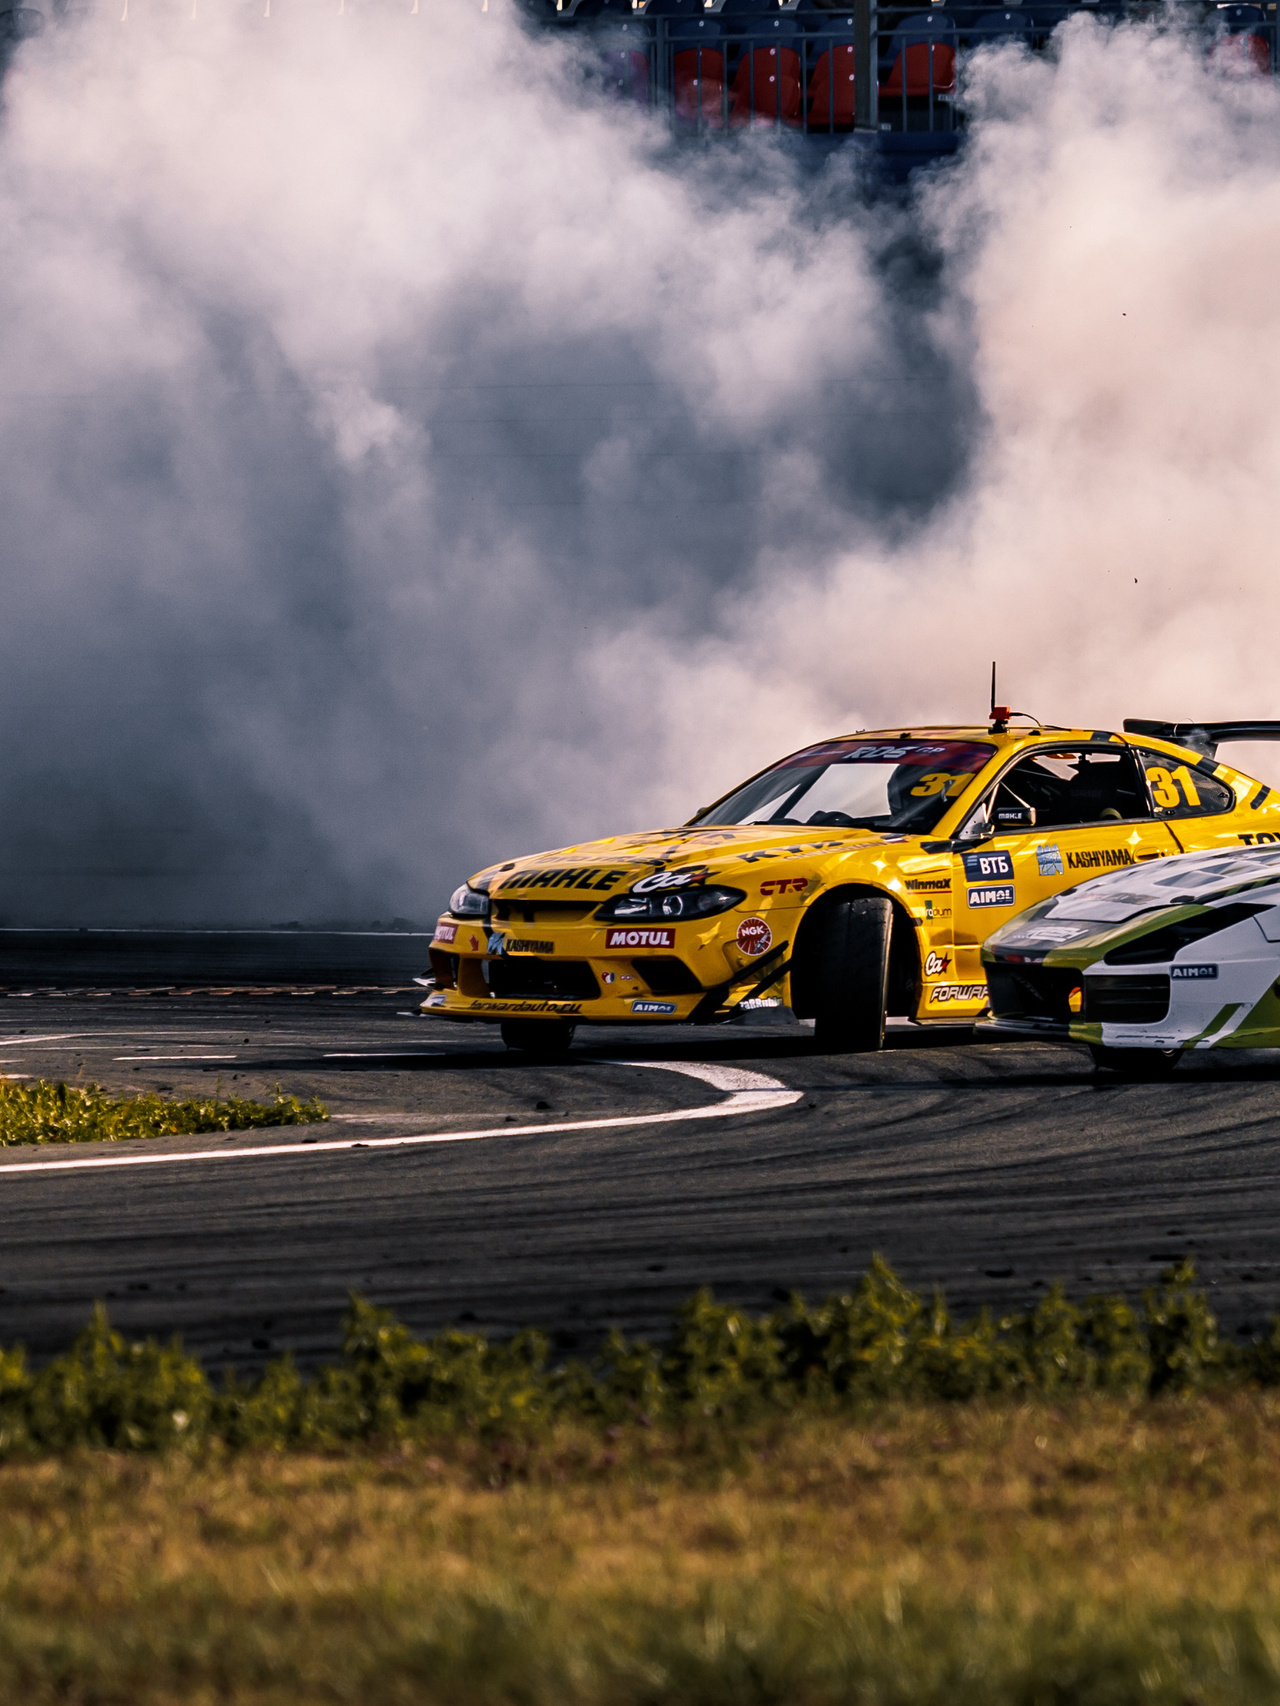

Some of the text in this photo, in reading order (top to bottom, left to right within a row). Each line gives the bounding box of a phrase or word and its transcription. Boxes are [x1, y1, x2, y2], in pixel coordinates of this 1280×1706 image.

[910, 773, 975, 796] 31
[1146, 766, 1201, 807] 31
[981, 856, 1009, 875] ВТБ
[1065, 848, 1132, 869] KASHIYAMA
[498, 869, 628, 890] MAHLE
[760, 877, 809, 896] CTR
[969, 889, 1013, 904] AIMOL
[610, 931, 671, 946] MOTUL
[741, 925, 765, 937] NGK
[506, 938, 555, 954] KASHIYAMA
